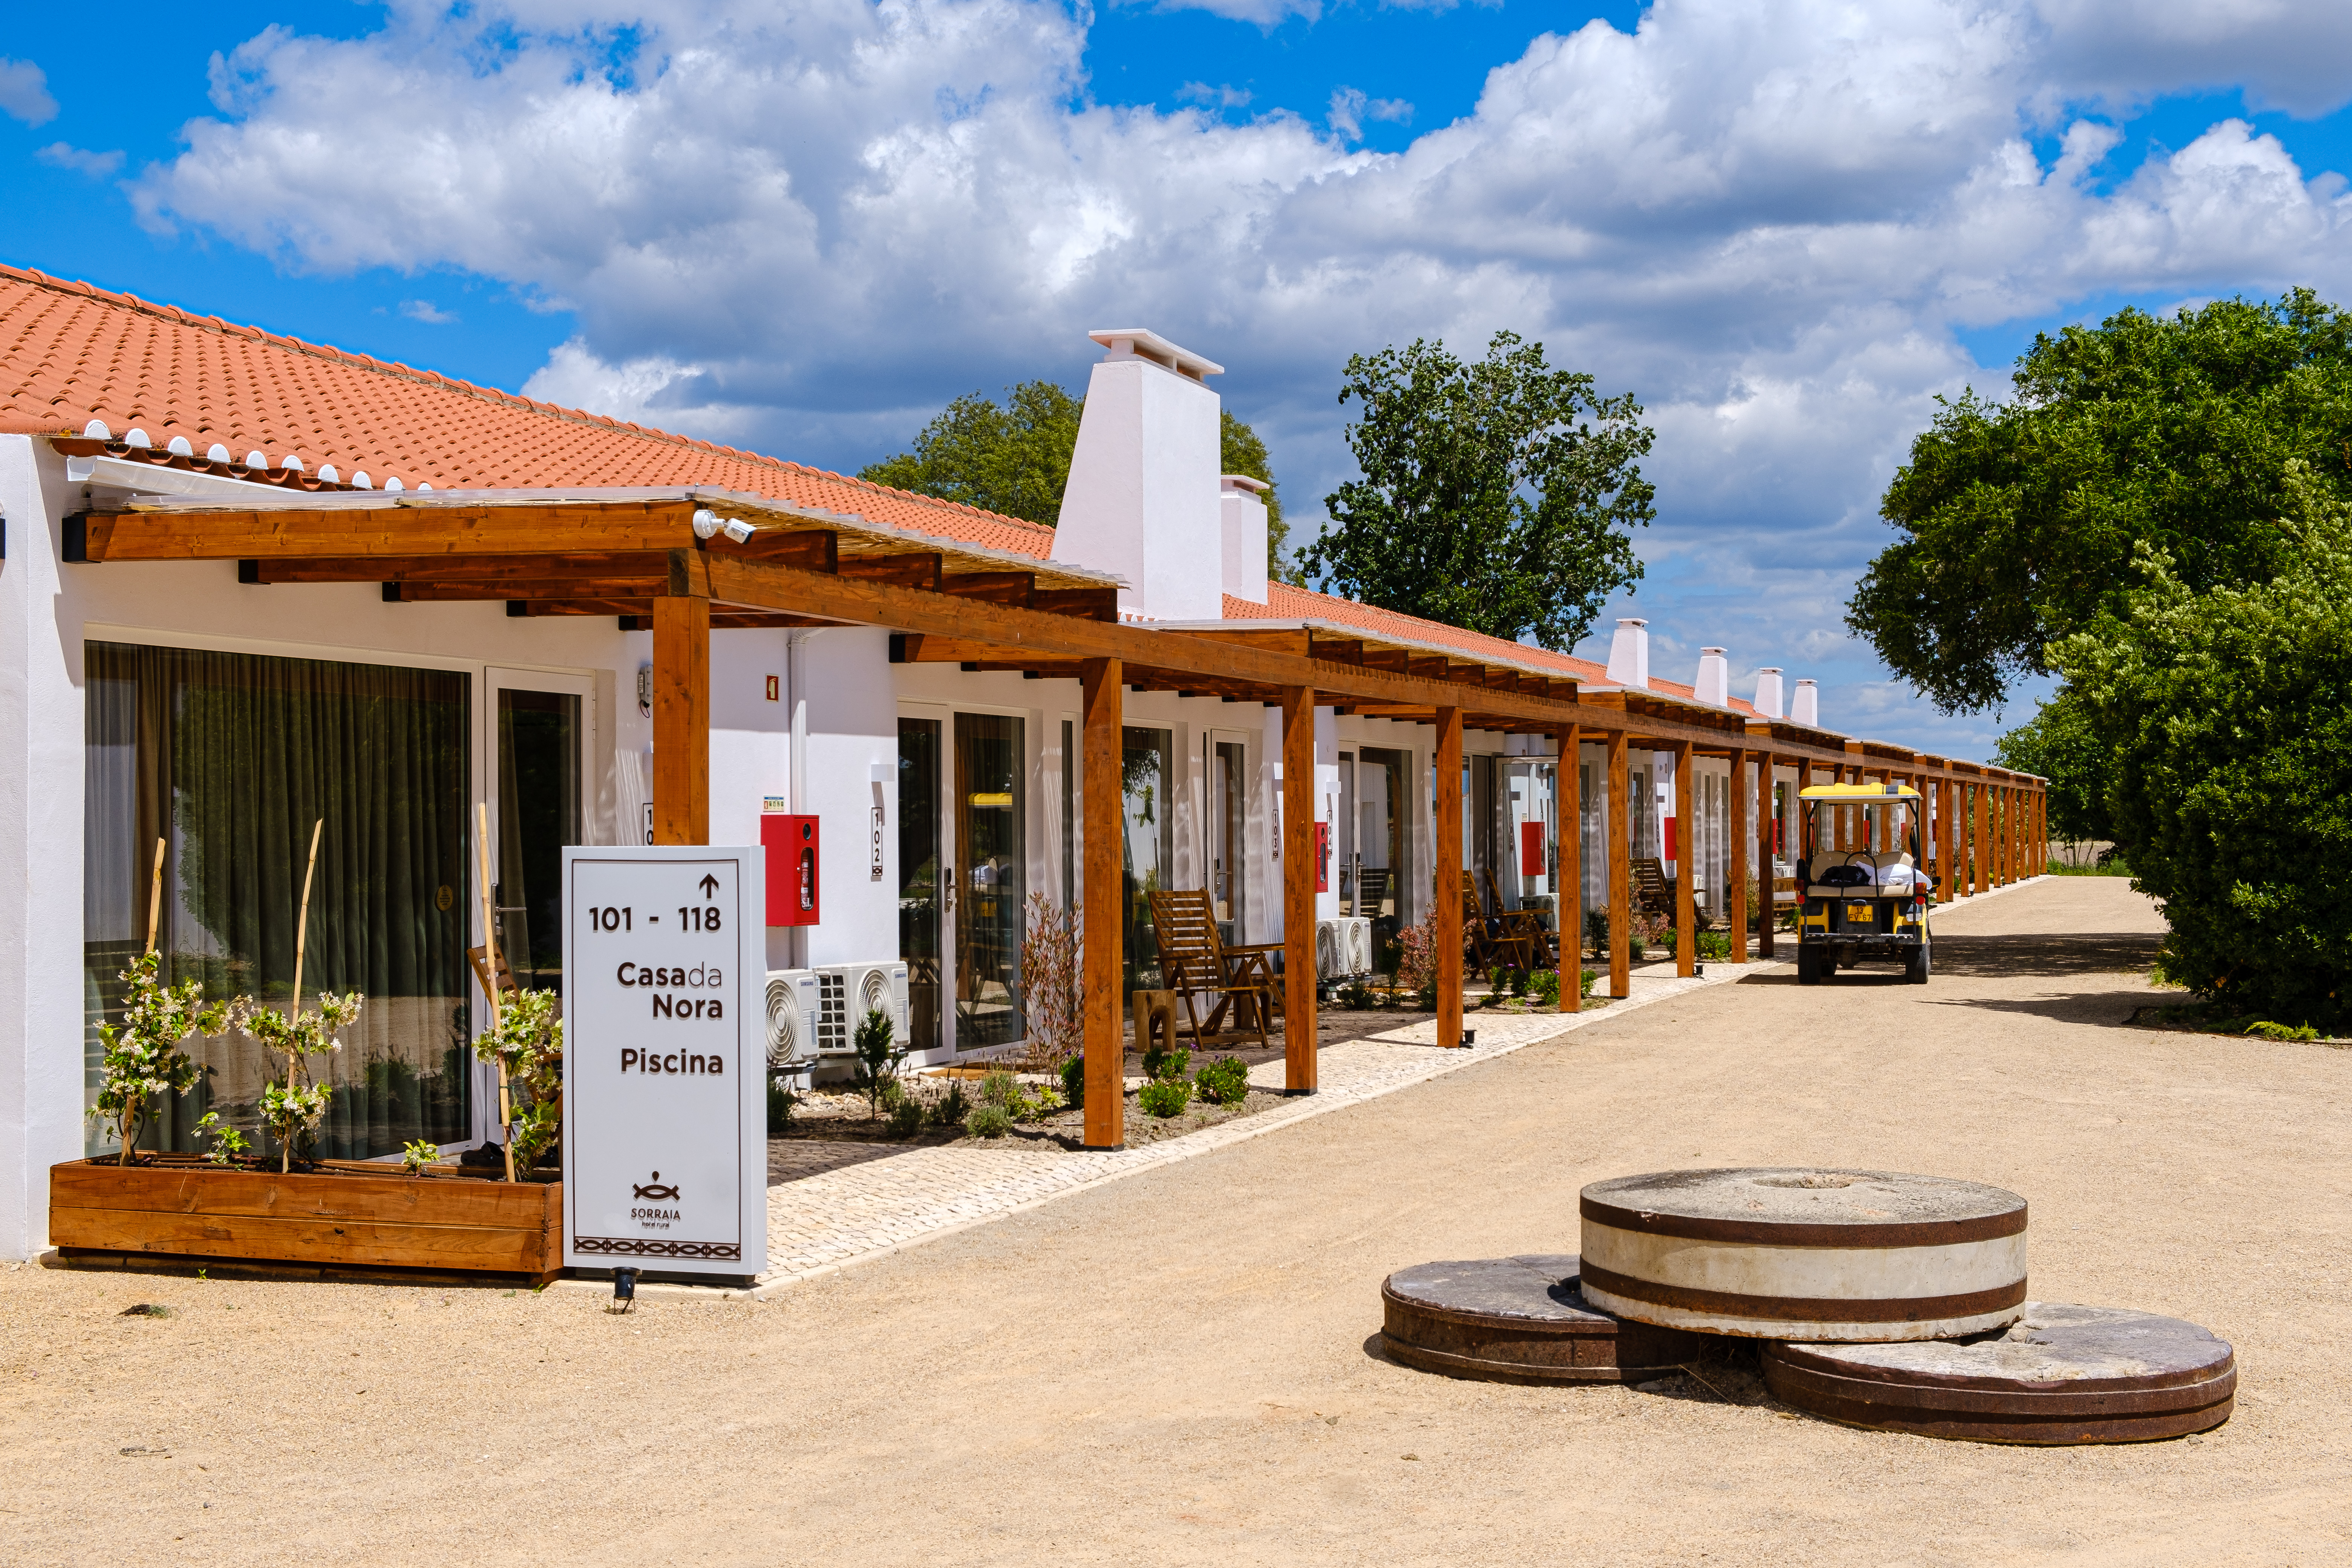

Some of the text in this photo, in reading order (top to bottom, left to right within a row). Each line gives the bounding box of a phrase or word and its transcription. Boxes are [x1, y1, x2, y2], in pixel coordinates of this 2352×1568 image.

[589, 907, 631, 931] 101
[678, 906, 721, 931] 118
[653, 994, 723, 1018] Nora
[621, 1048, 723, 1074] Piscina
[631, 1208, 680, 1220] SORRAIA
